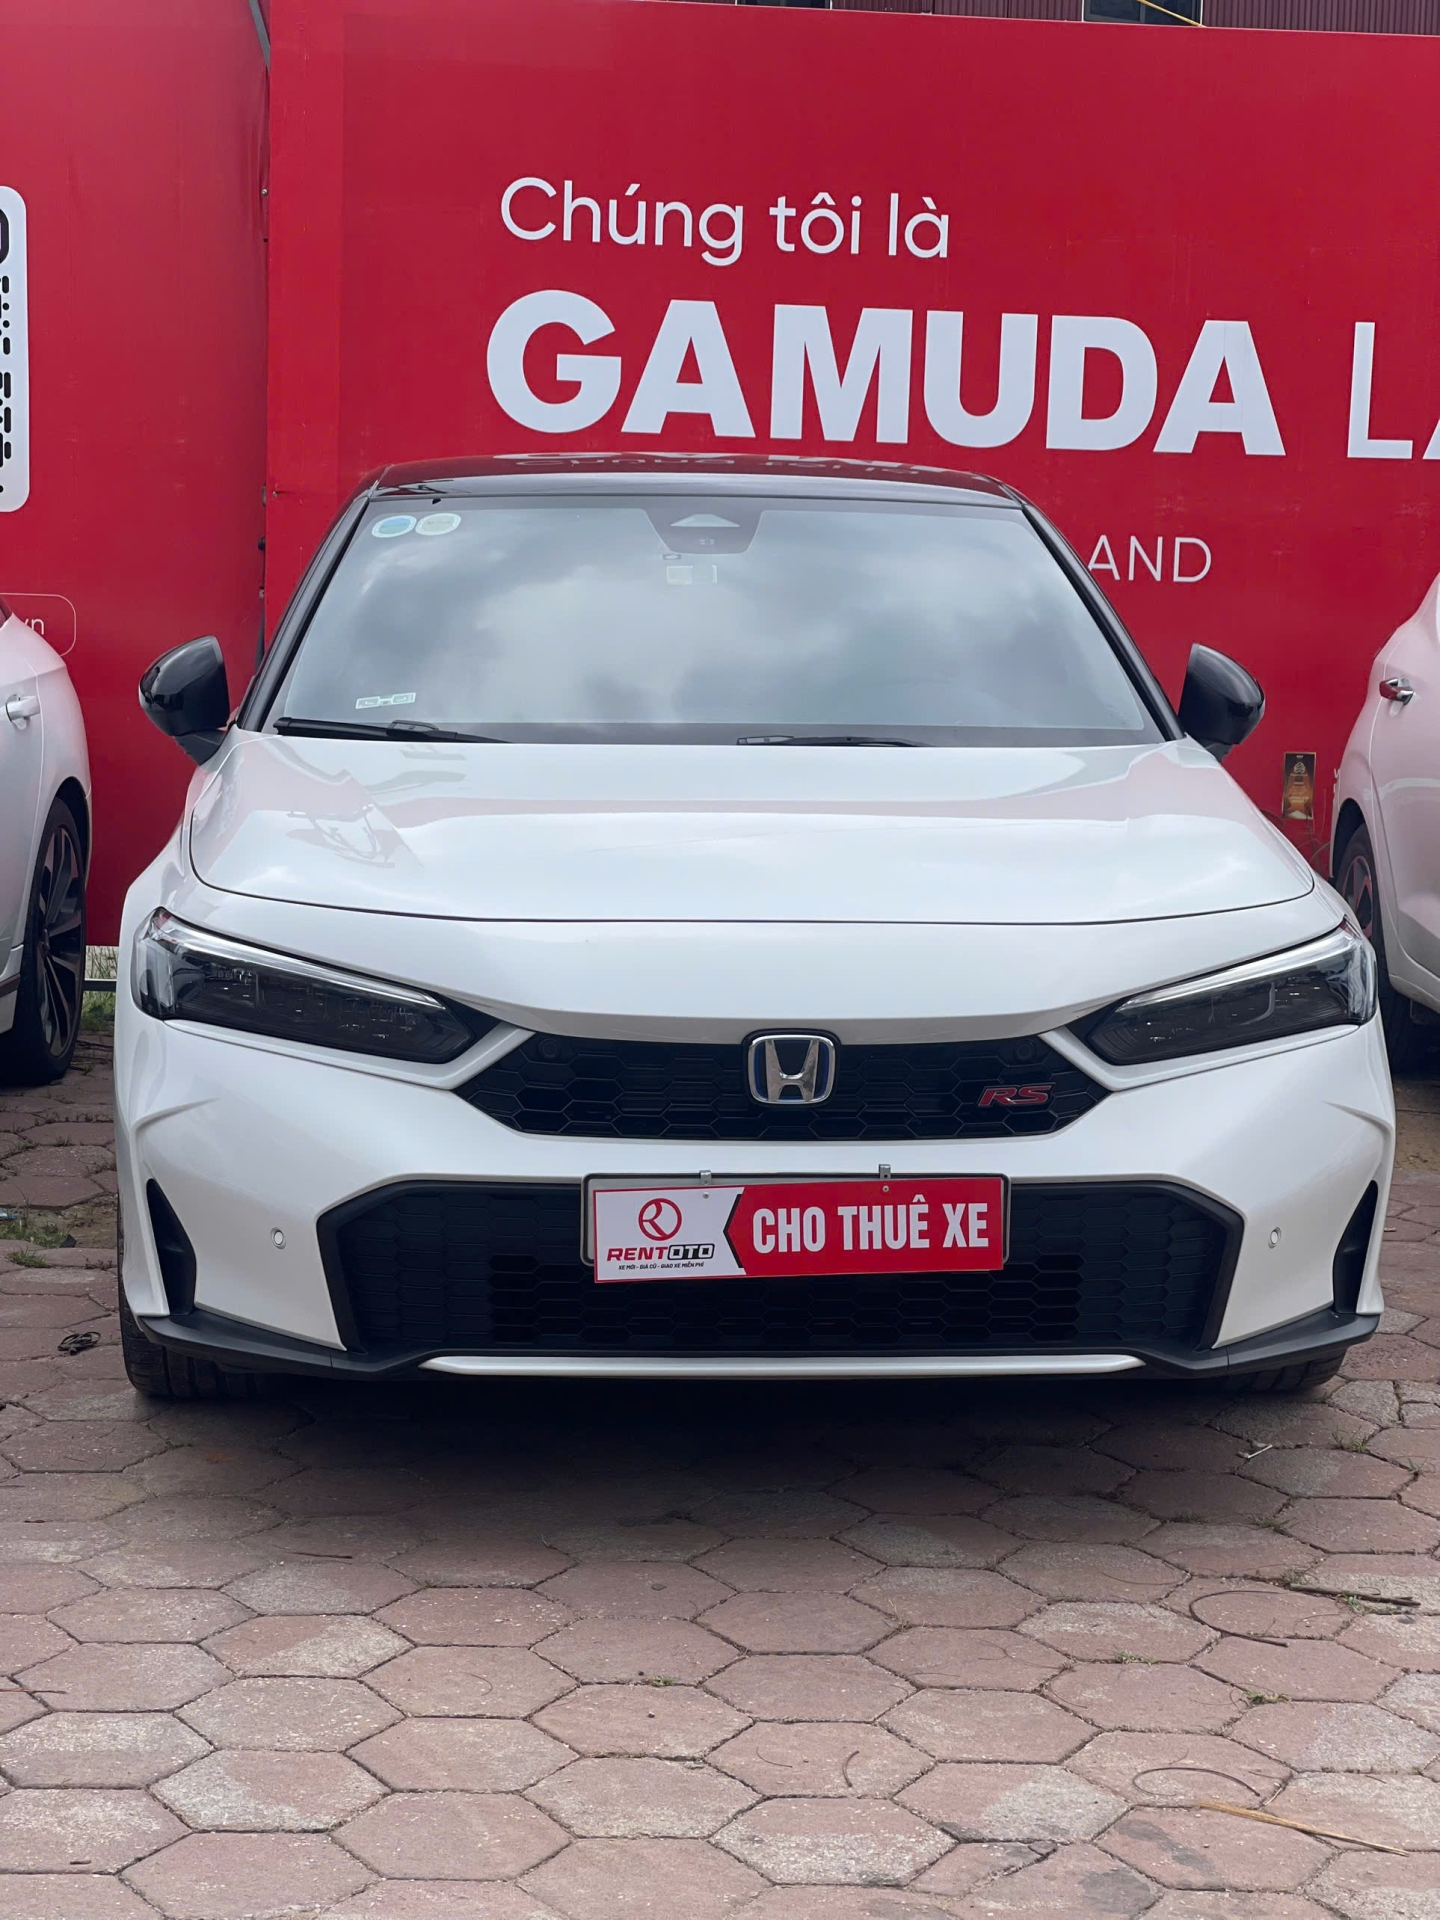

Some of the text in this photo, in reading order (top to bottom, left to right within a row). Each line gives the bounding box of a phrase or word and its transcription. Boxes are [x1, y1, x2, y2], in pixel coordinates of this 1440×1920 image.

[500, 176, 949, 267] Chúng tôi là
[486, 289, 1440, 460] GAMUDA L
[978, 1084, 1052, 1106] RS
[752, 1194, 989, 1254] CHO THUÊ XE
